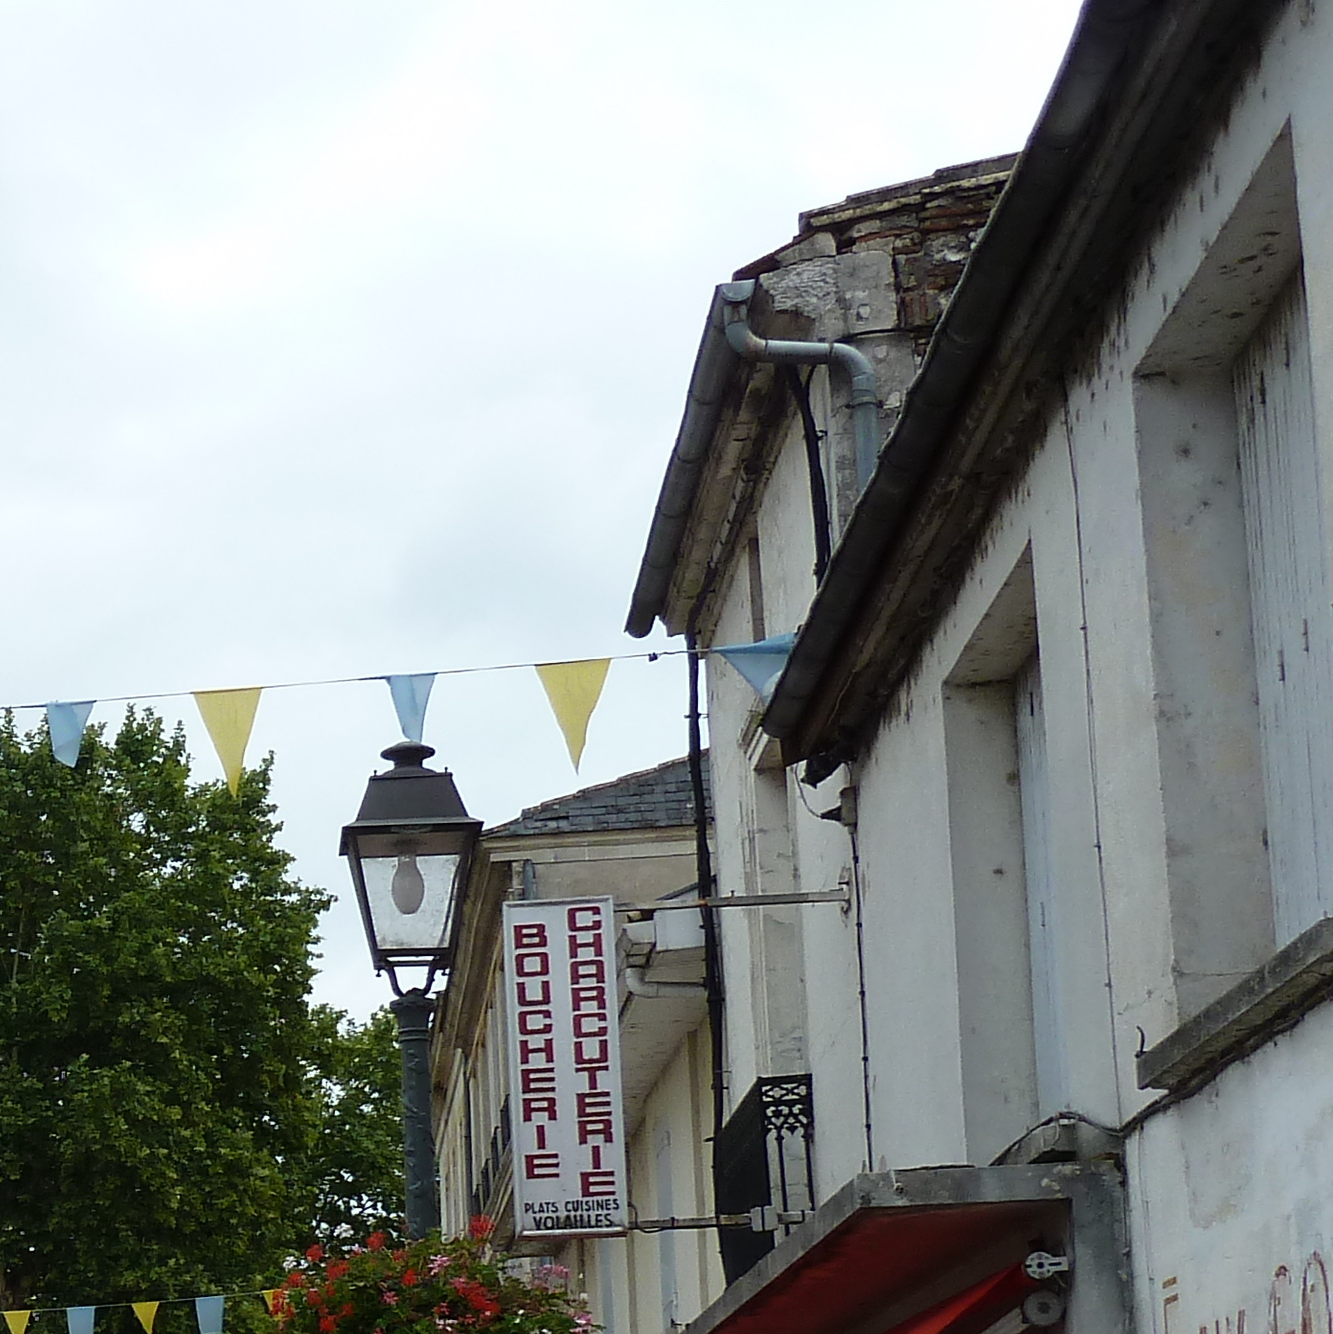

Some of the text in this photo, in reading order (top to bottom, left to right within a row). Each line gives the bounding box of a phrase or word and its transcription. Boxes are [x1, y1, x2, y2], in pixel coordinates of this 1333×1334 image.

[513, 923, 560, 1179] BOUCHERIE
[567, 906, 616, 1197] CHARCUTERIE
[524, 1198, 620, 1214] PLATS CUISINES
[532, 1213, 613, 1230] VOLAILLES
